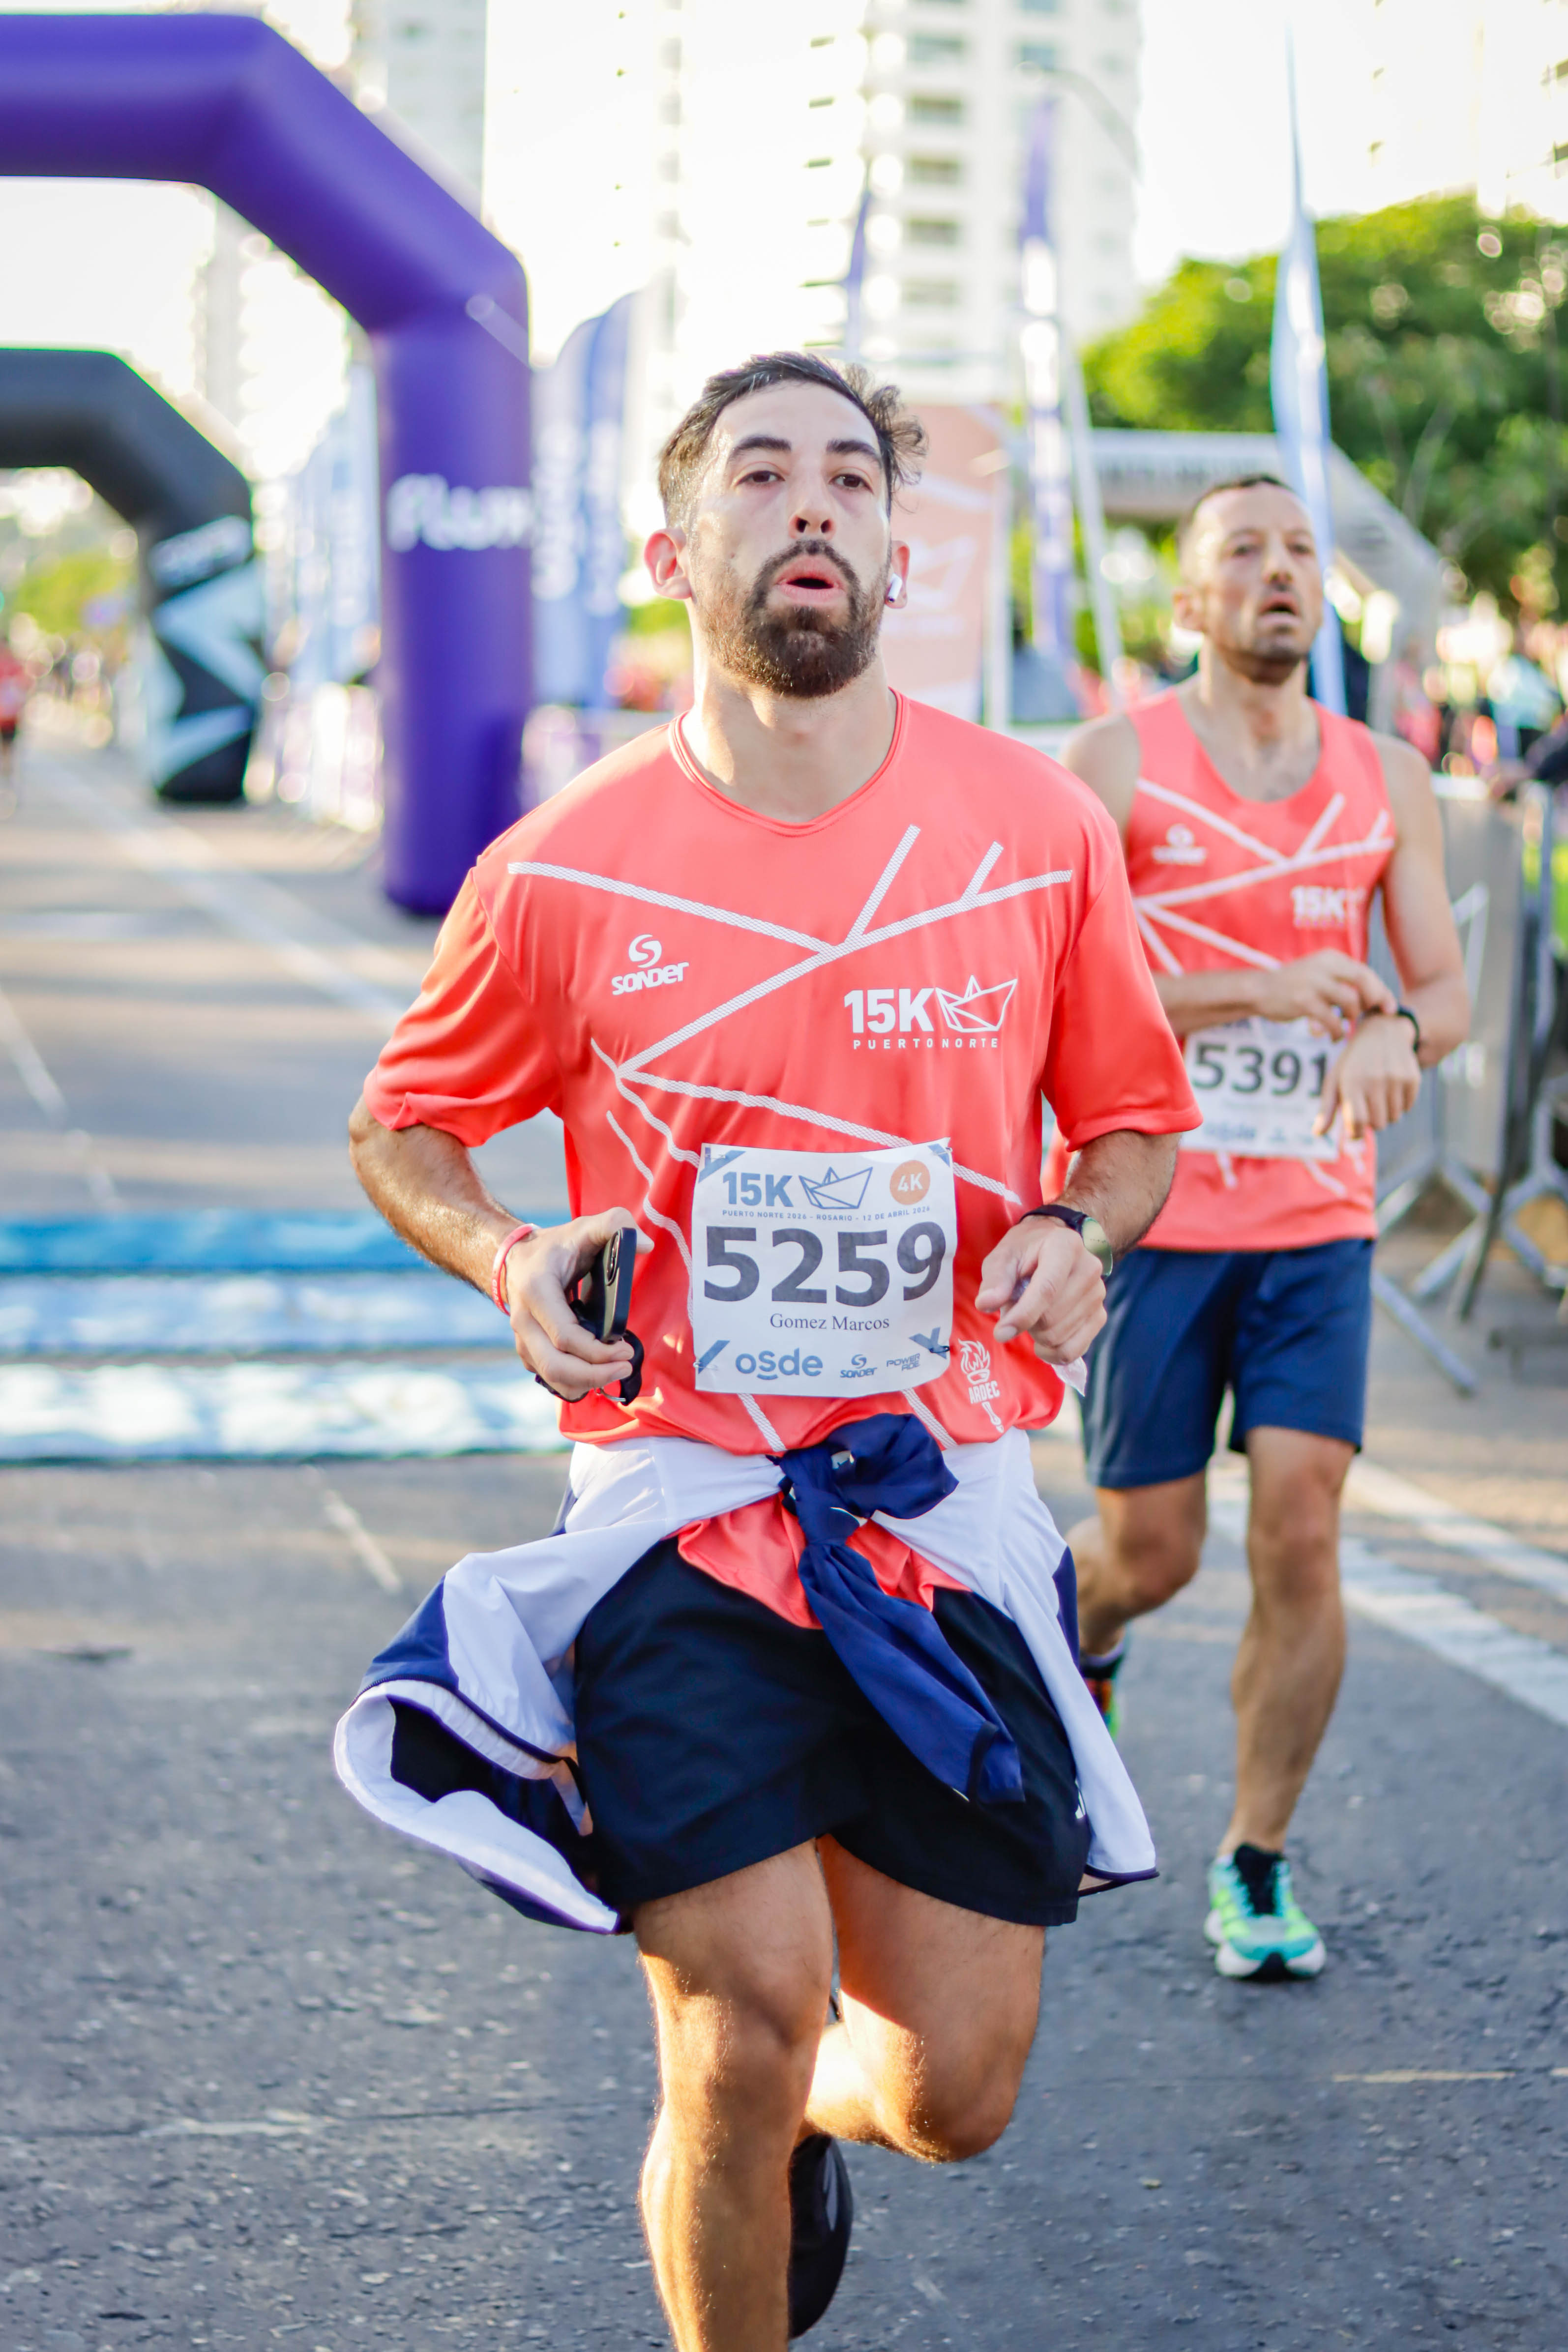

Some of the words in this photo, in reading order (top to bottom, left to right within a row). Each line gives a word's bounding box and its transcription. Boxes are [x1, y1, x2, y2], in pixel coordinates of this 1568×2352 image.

[844, 988, 934, 1033] 15K
[1191, 1042, 1328, 1098] 5391
[722, 1172, 795, 1207] 15K
[898, 1173, 922, 1192] 4K
[888, 1209, 910, 1218] ABRIL
[704, 1221, 947, 1307] 5259
[769, 1313, 827, 1329] Gomez
[832, 1316, 889, 1331] Marcos
[735, 1347, 823, 1378] osde
[887, 1352, 920, 1367] POWER
[968, 1380, 1000, 1405] ARDEC
